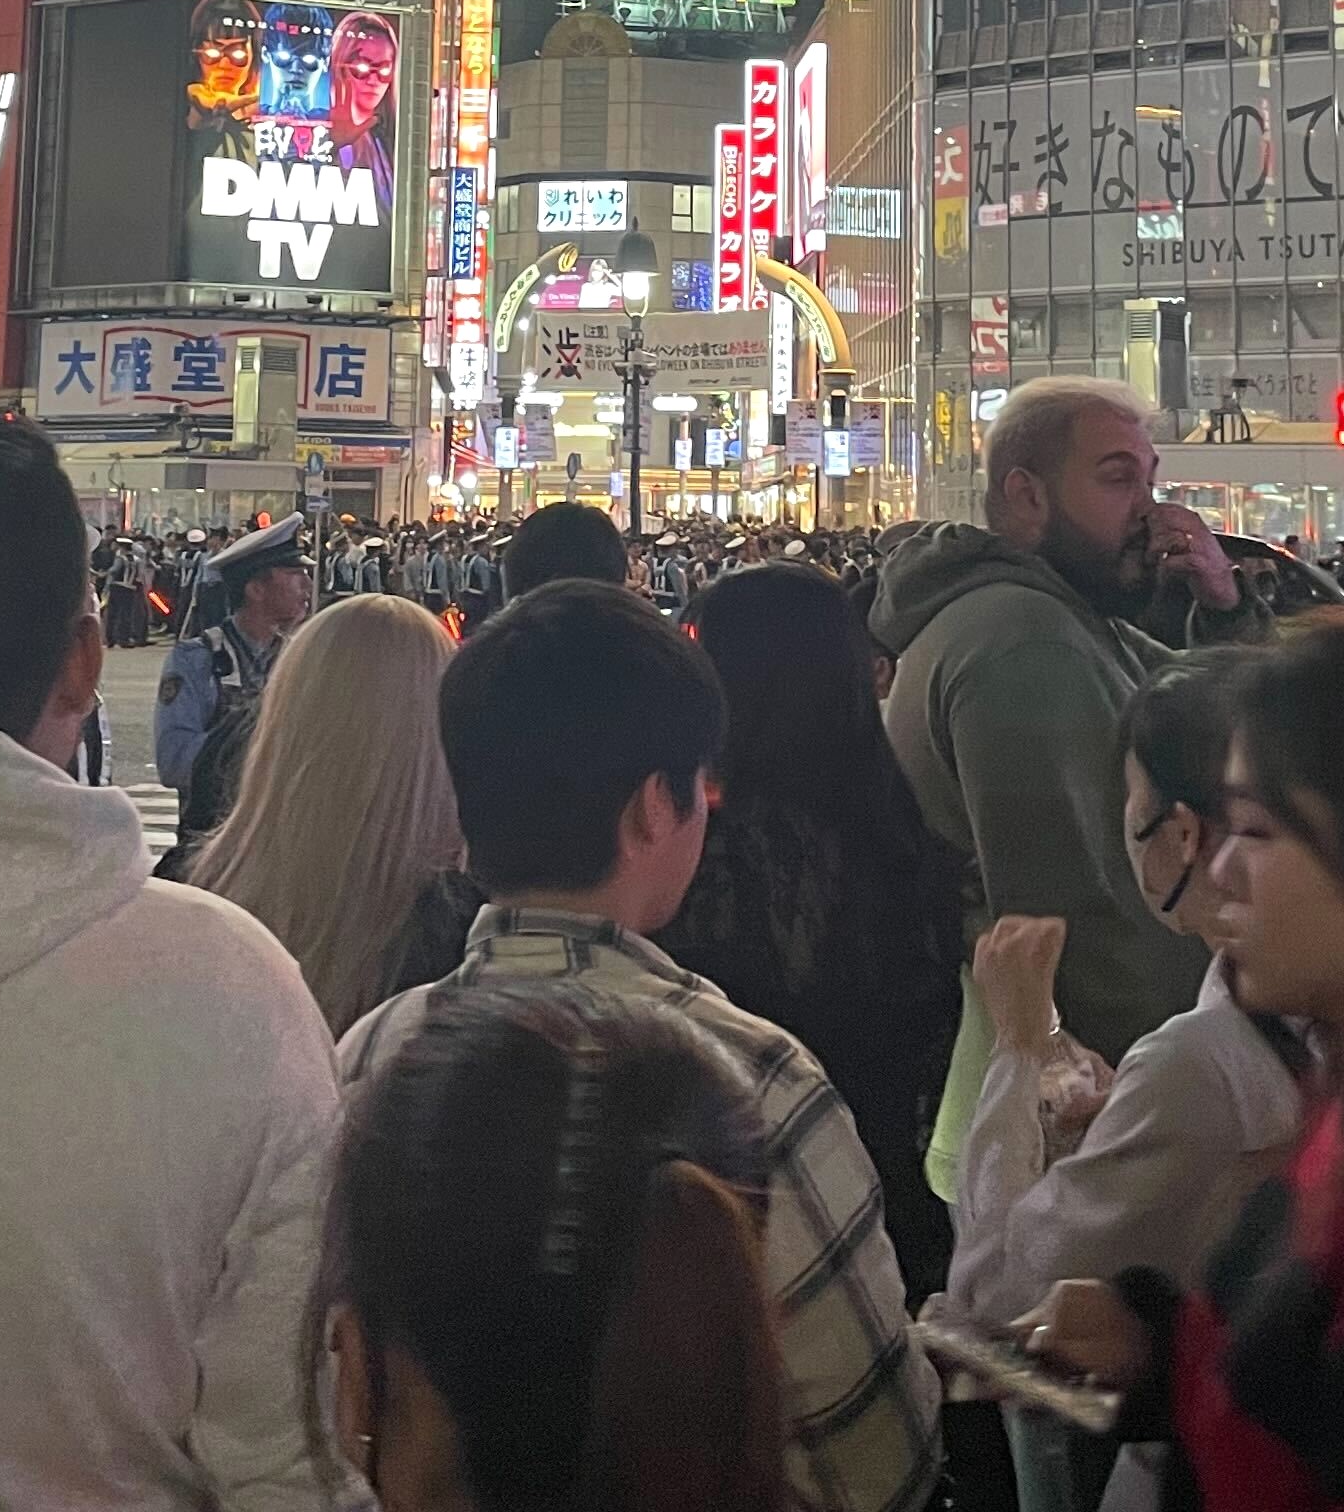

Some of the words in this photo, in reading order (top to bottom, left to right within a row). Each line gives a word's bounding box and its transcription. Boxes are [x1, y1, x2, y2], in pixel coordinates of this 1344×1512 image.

[750, 80, 778, 214] カラオケ
[201, 155, 379, 227] DMM
[454, 172, 474, 274] 大盛堂商事ビル
[543, 209, 624, 227] クリニック
[564, 188, 624, 205] れいわ
[247, 218, 334, 281] TV
[1122, 236, 1244, 268] SHIBUYA
[55, 333, 368, 400] 大盛堂店
